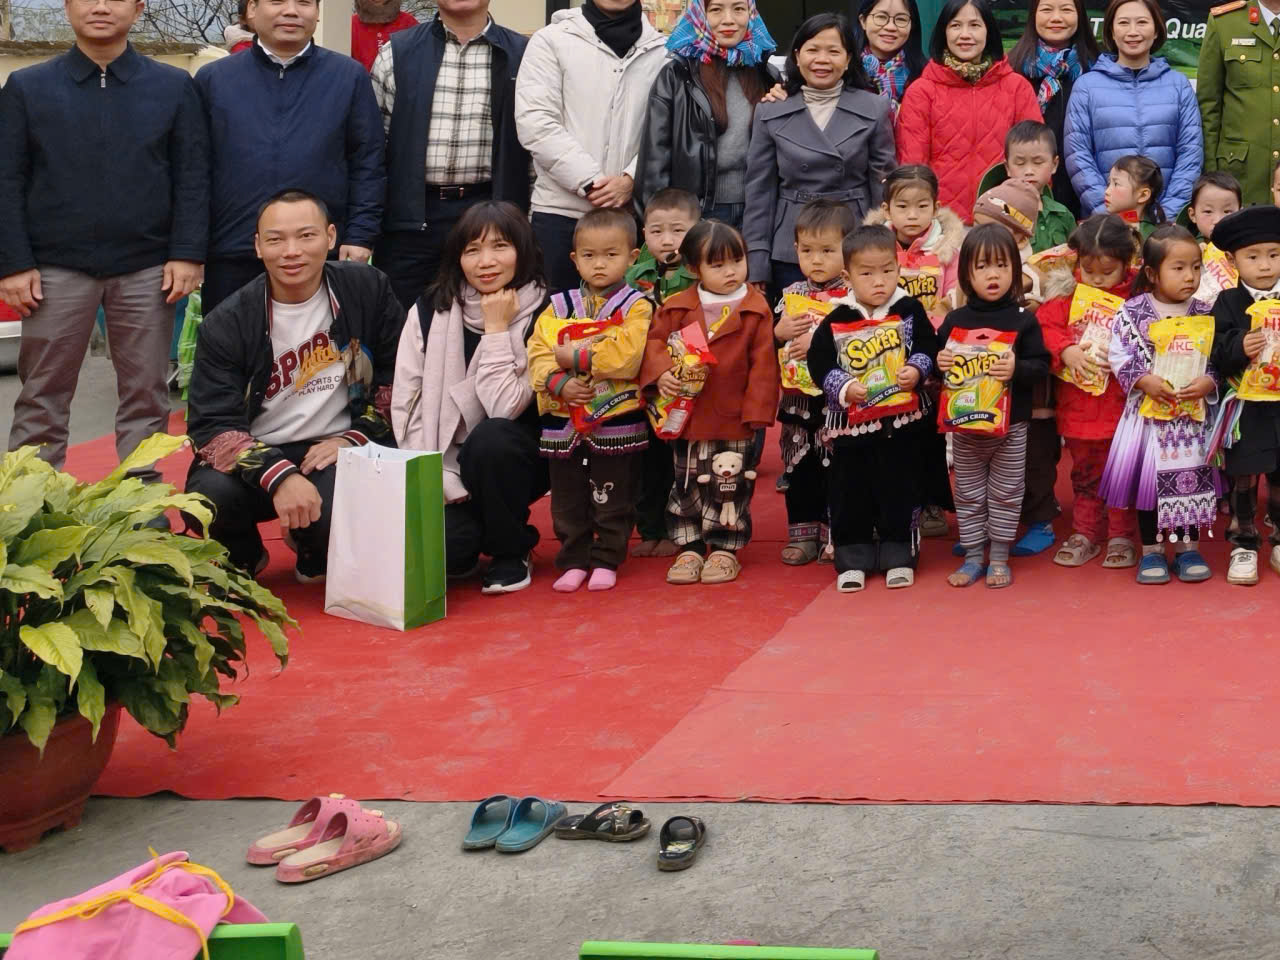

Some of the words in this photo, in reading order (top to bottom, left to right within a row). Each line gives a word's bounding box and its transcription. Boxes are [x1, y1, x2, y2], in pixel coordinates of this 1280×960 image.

[1165, 18, 1207, 39] Qua
[846, 327, 902, 370] SUKER
[317, 384, 335, 392] HARD
[884, 386, 901, 396] CRIS
